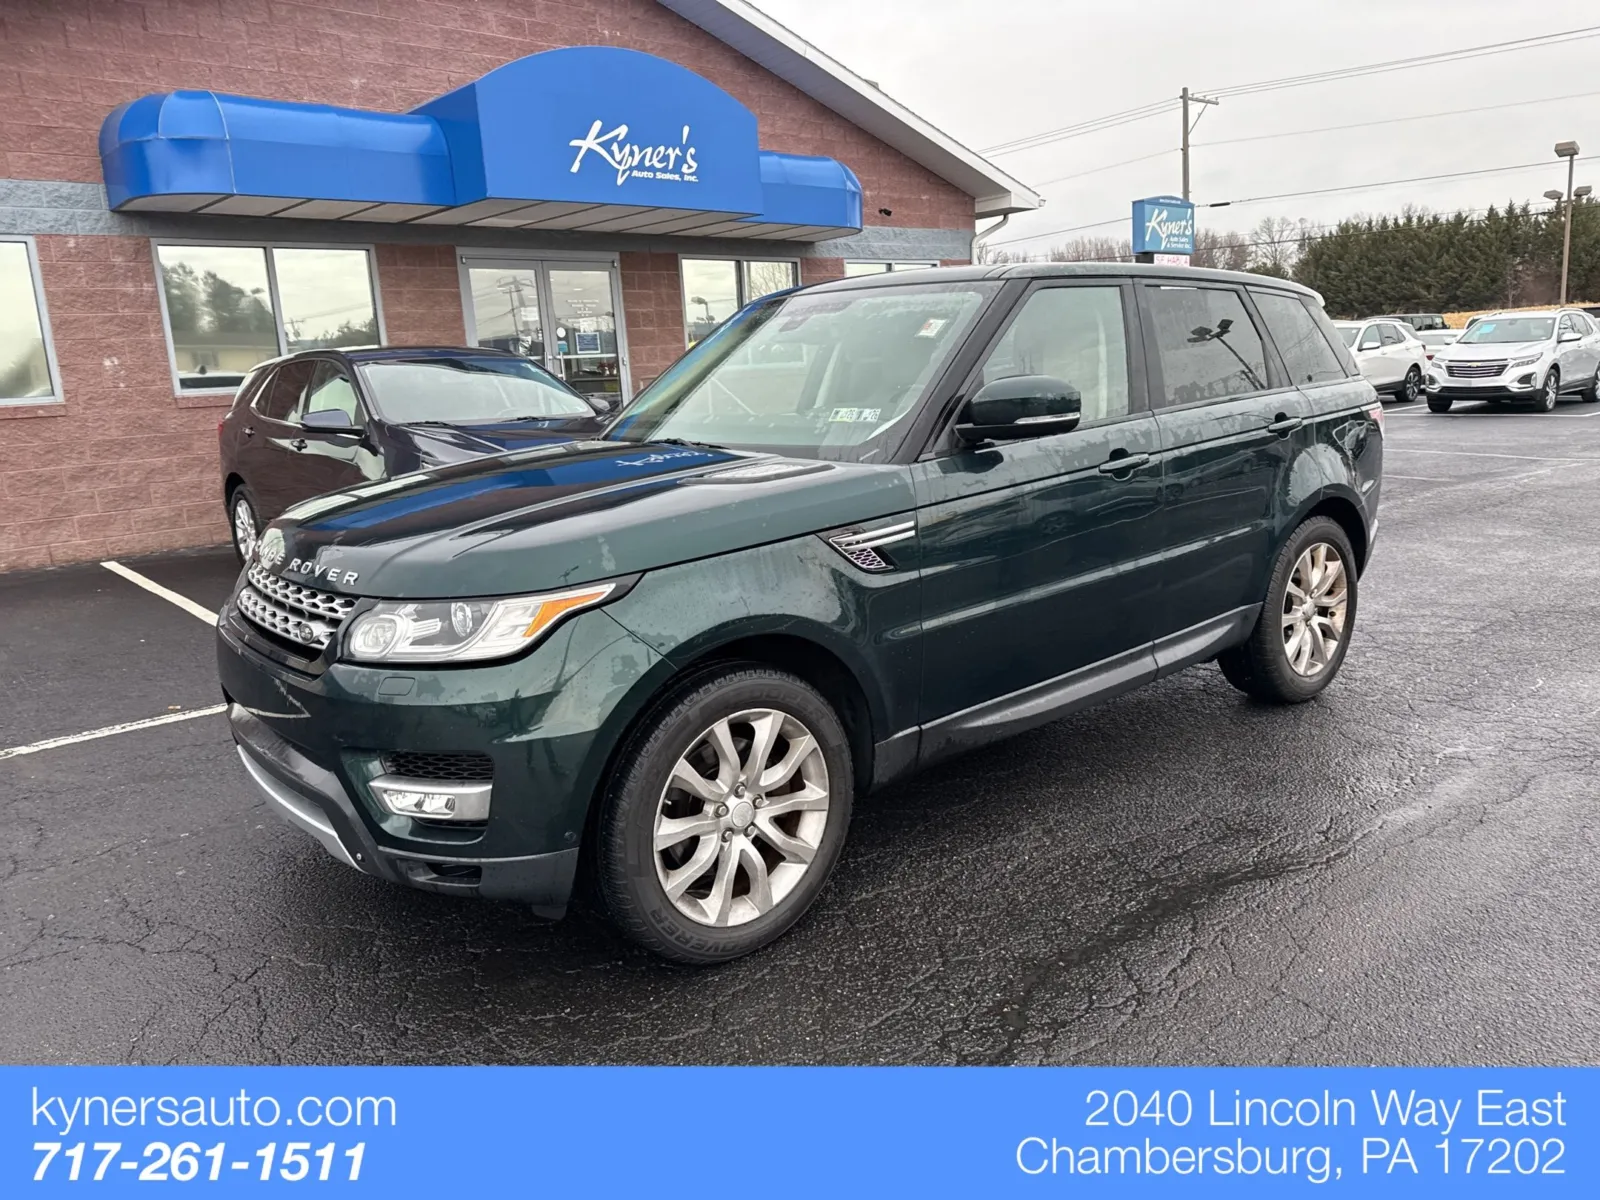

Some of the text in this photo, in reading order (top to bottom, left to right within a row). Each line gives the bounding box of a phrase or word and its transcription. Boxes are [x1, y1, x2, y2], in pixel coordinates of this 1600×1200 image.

[569, 119, 698, 186] Kyner's
[631, 170, 699, 182] Auto Sales, Inc.
[1145, 208, 1192, 251] Kyner's
[289, 557, 359, 586] ROVER
